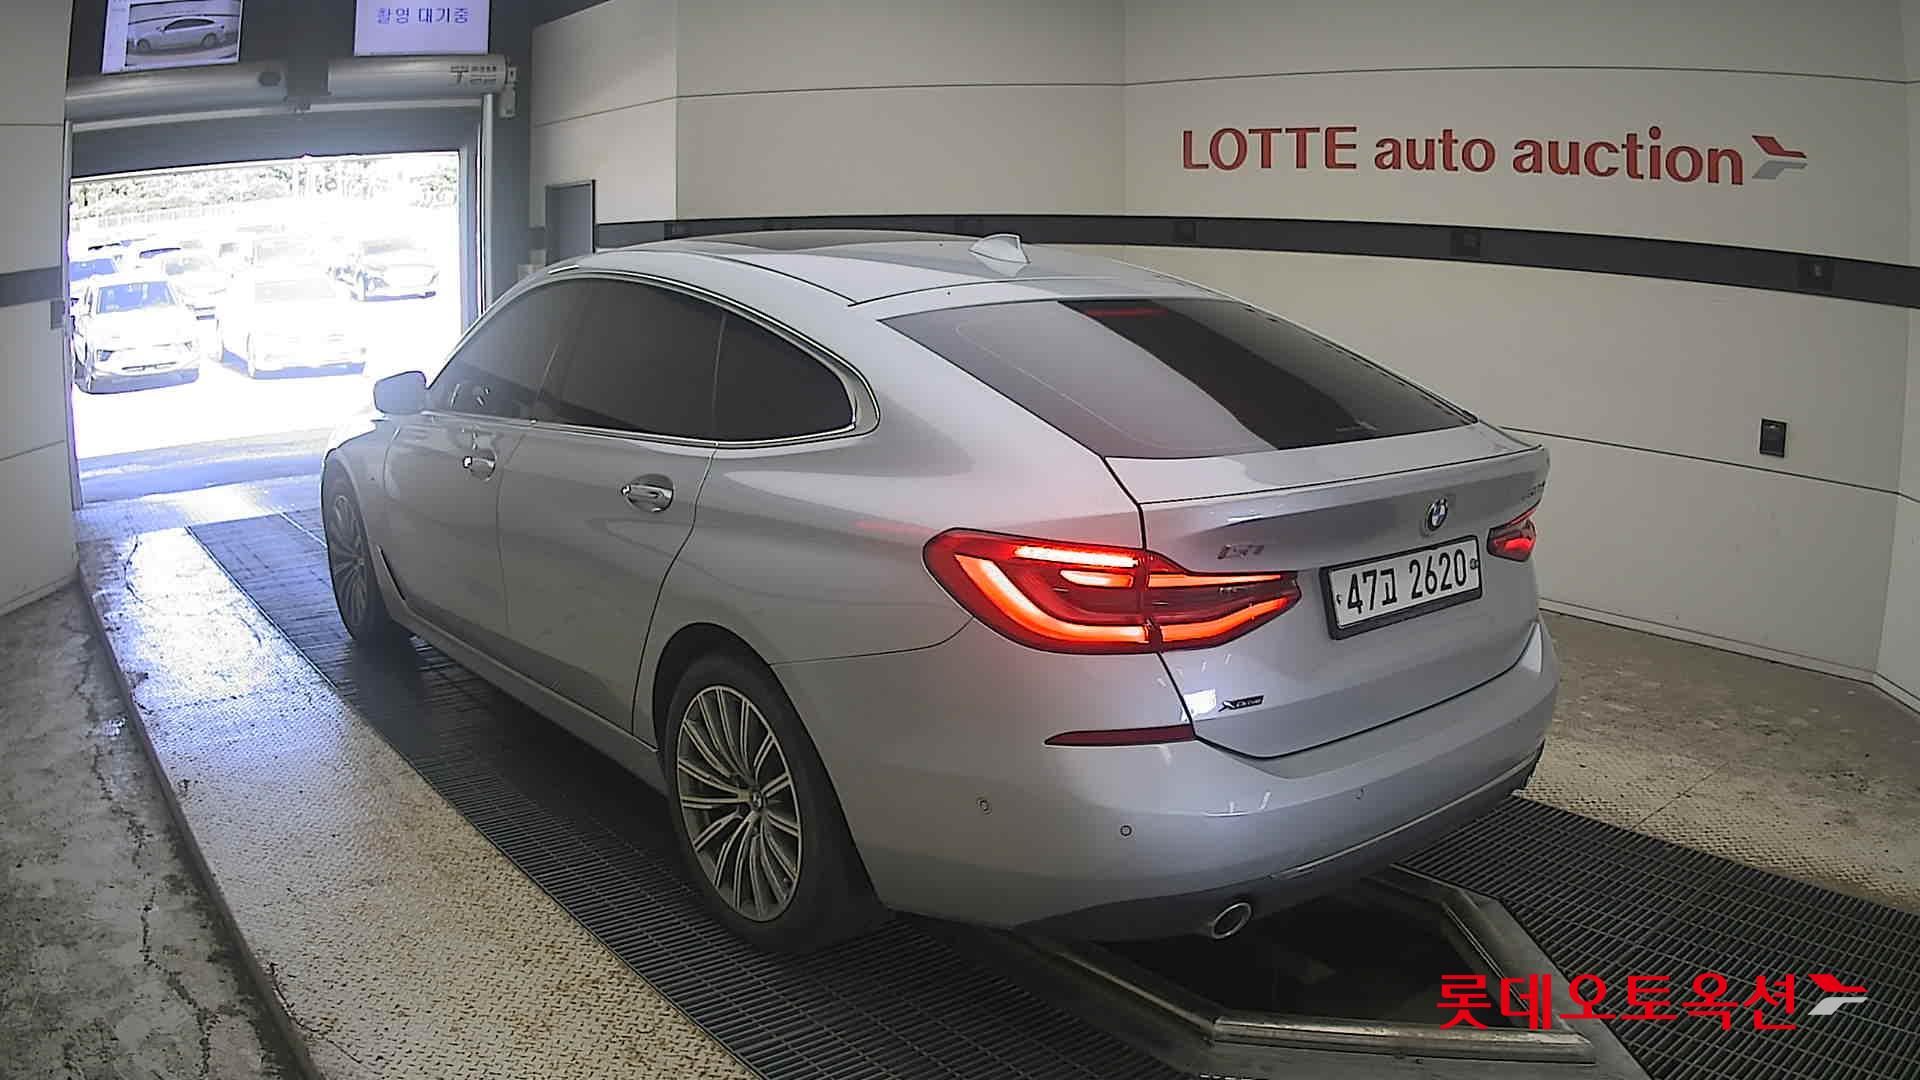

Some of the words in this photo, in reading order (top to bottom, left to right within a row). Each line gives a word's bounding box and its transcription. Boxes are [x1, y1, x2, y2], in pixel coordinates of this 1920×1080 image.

[1183, 126, 1357, 170] LOTTE
[1374, 128, 1496, 172] auto
[1512, 125, 1744, 185] auction
[1409, 549, 1467, 600] 2620
